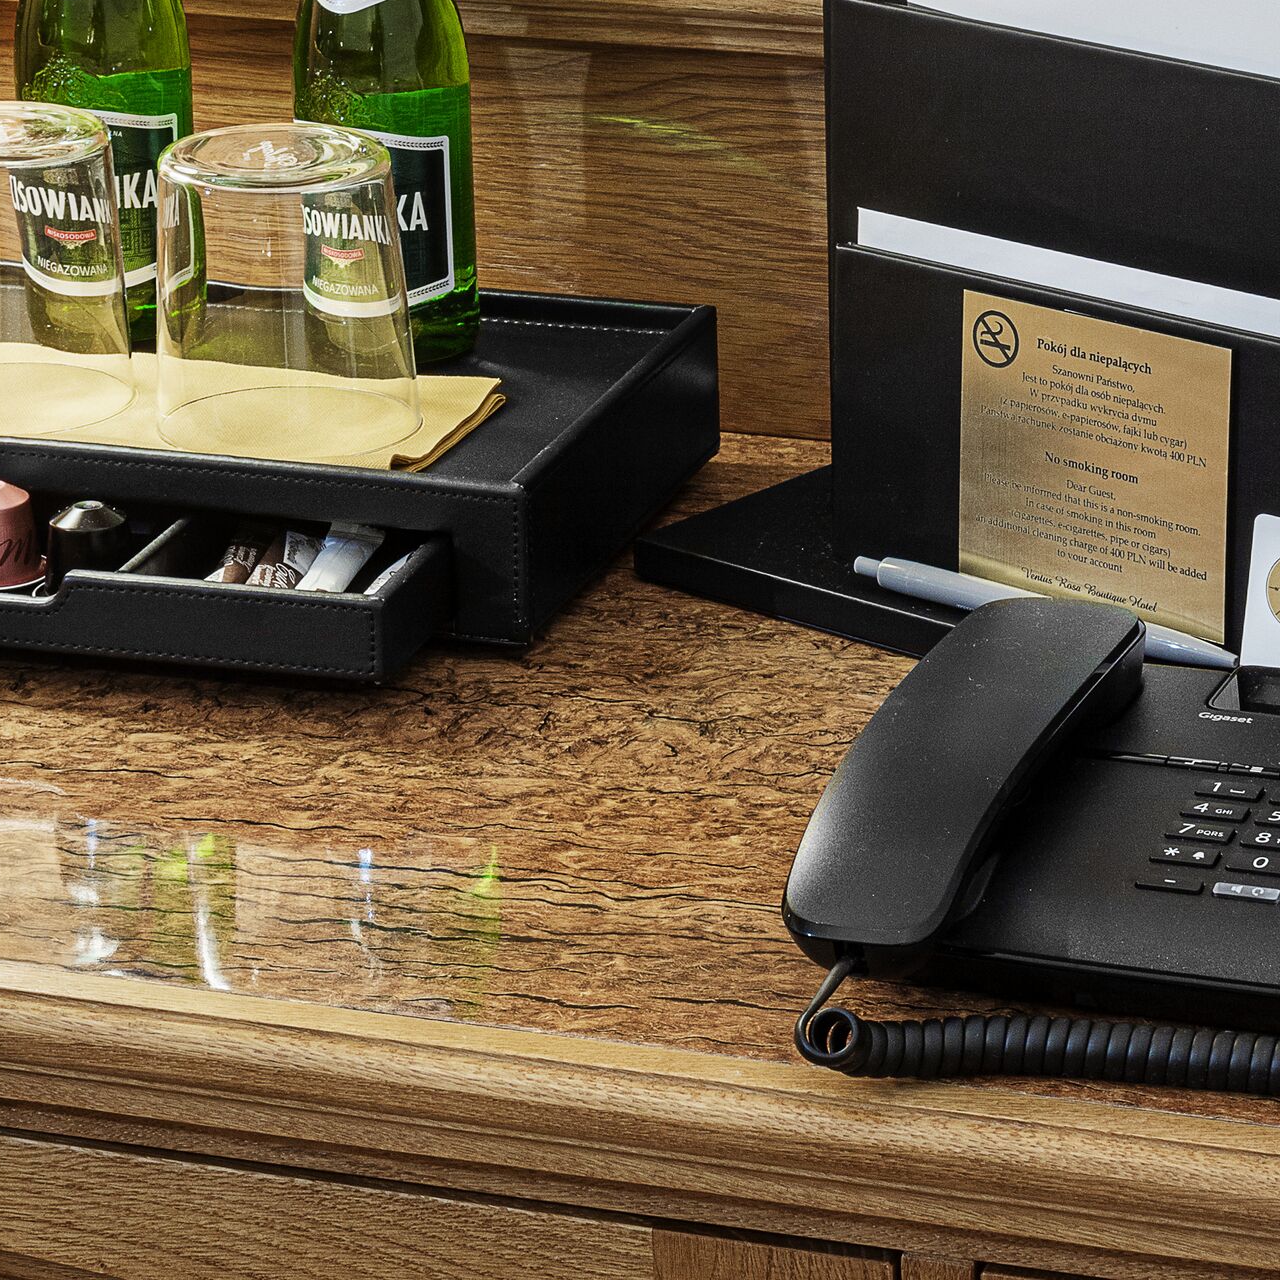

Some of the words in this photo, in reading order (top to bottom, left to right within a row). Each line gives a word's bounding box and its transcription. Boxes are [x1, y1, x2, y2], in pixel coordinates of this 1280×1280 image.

[37, 256, 108, 276] NIEGAZOWANA
[312, 275, 379, 296] NIEGAZOWANA
[1037, 338, 1067, 357] Pokój
[1070, 346, 1086, 359] dla
[1089, 352, 1152, 375] niepalących
[1052, 365, 1094, 383] Szanowni
[1096, 375, 1135, 393] Państwo,
[1022, 372, 1037, 384] Jest
[1039, 377, 1048, 386] to
[1050, 381, 1074, 394] pokój
[1075, 385, 1088, 396] dla
[1091, 391, 1111, 401] osób
[1113, 395, 1166, 414] niepalących.
[1030, 388, 1040, 397] W
[1041, 392, 1088, 409] przypadku
[1090, 403, 1129, 419] wykrycia
[1132, 413, 1157, 427] dymu
[1017, 415, 1057, 431] rachunek
[1059, 425, 1093, 440] zostanie
[1141, 443, 1168, 460] kwotą
[1169, 451, 1185, 462] 400
[1187, 454, 1207, 468] PLN
[1062, 412, 1121, 433] e-papierosów,
[1123, 425, 1141, 438] fajki
[1144, 430, 1158, 442] lub
[1160, 436, 1187, 449] cygar)
[1045, 451, 1060, 465] No
[1063, 458, 1109, 480] smoking
[1111, 470, 1139, 484] room
[1066, 480, 1087, 492] Dear
[1089, 485, 1116, 500] Guest,
[984, 472, 1009, 487] Please
[1024, 485, 1062, 500] informed
[1064, 493, 1081, 506] that
[1083, 498, 1099, 510] this
[1101, 502, 1108, 512] is
[1117, 508, 1174, 532] non-smoking
[1175, 522, 1201, 536] room.
[1036, 502, 1054, 513] case
[1056, 505, 1065, 515] of
[1067, 509, 1103, 527] smoking
[1105, 517, 1114, 528] in
[1116, 520, 1132, 532] this
[1133, 527, 1156, 539] room
[976, 514, 985, 523] an
[988, 516, 1030, 535] additional
[1032, 528, 1067, 547] cleaning
[1069, 538, 1098, 553] charge
[1100, 545, 1109, 554] of
[1110, 548, 1125, 559] 400
[1127, 552, 1147, 565] PLN
[1149, 559, 1165, 570] will
[1168, 562, 1178, 573] be
[1180, 567, 1207, 580] added
[1110, 535, 1129, 547] pipe
[1131, 540, 1140, 549] or
[1142, 543, 1171, 558] cigars)
[1057, 549, 1066, 558] to
[1067, 552, 1088, 563] your
[1089, 558, 1123, 573] account
[1021, 566, 1053, 585] Ventus
[1055, 575, 1081, 592] Rosa
[1084, 582, 1127, 604] Boutique
[1129, 595, 1158, 613] Hotel
[1198, 711, 1254, 724] Gigaset
[1212, 782, 1222, 792] 1
[1193, 803, 1209, 813] 4
[1178, 823, 1196, 834] 7
[1196, 828, 1225, 838] PQRS
[1254, 832, 1272, 844] 8
[1252, 856, 1270, 869] 0
